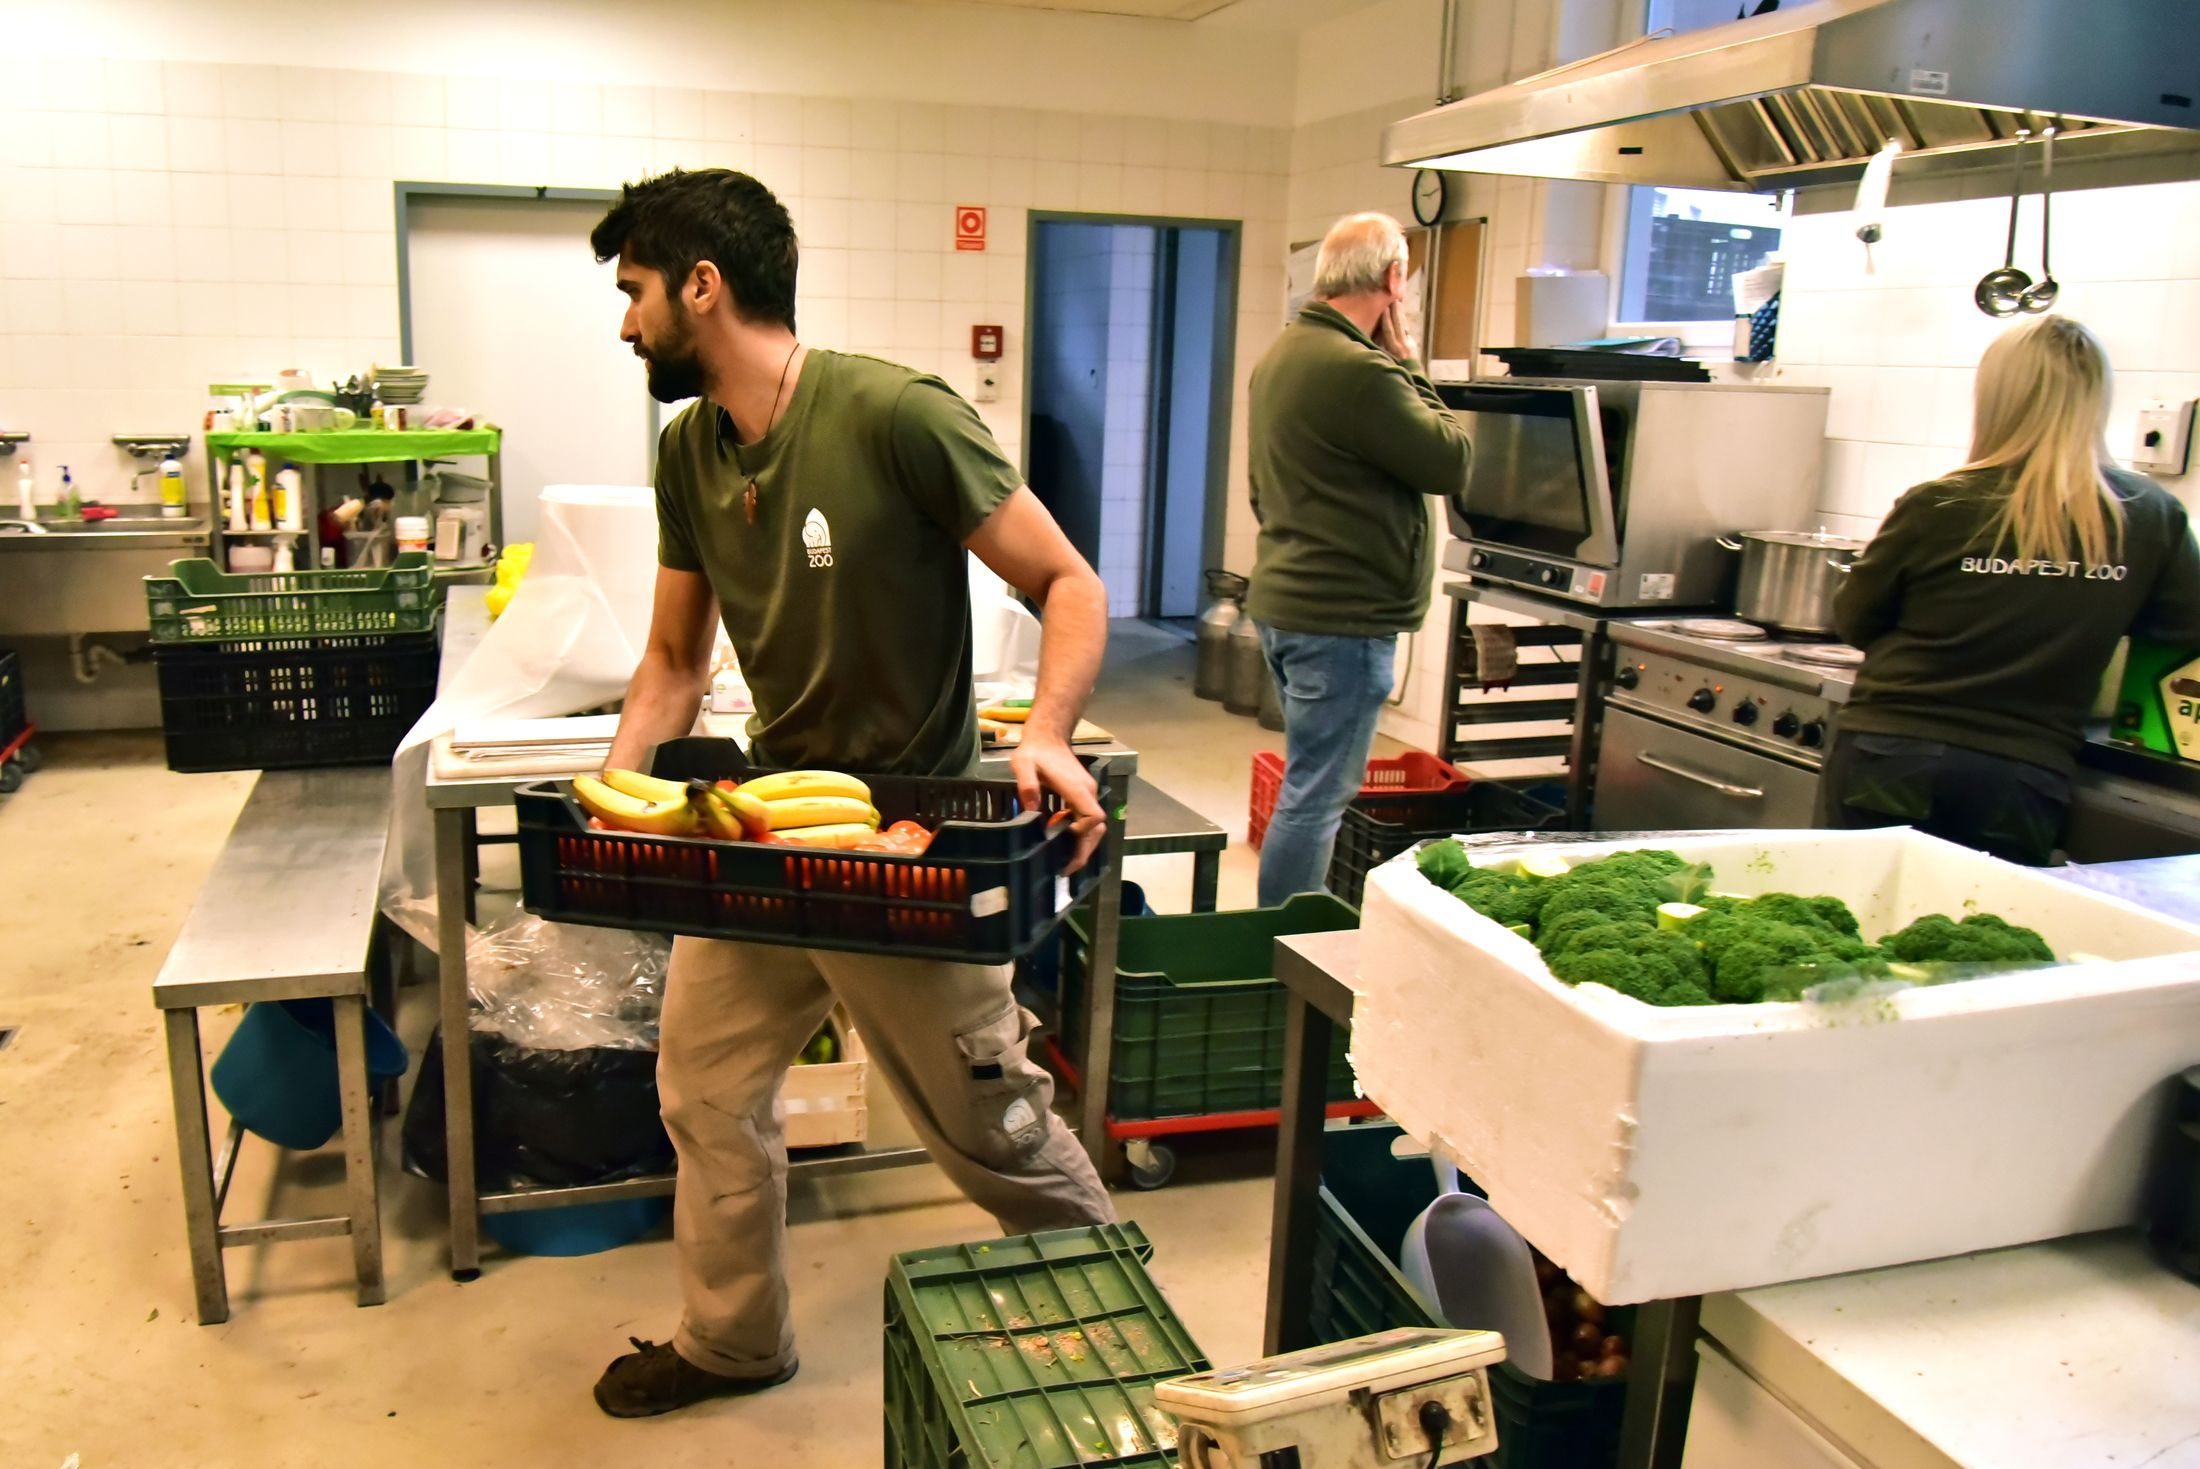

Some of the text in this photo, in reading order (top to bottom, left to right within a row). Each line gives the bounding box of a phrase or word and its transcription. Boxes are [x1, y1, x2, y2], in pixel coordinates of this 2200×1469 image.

[808, 553, 833, 568] ZOO
[1961, 557, 2128, 581] BUDAPEST ZOO
